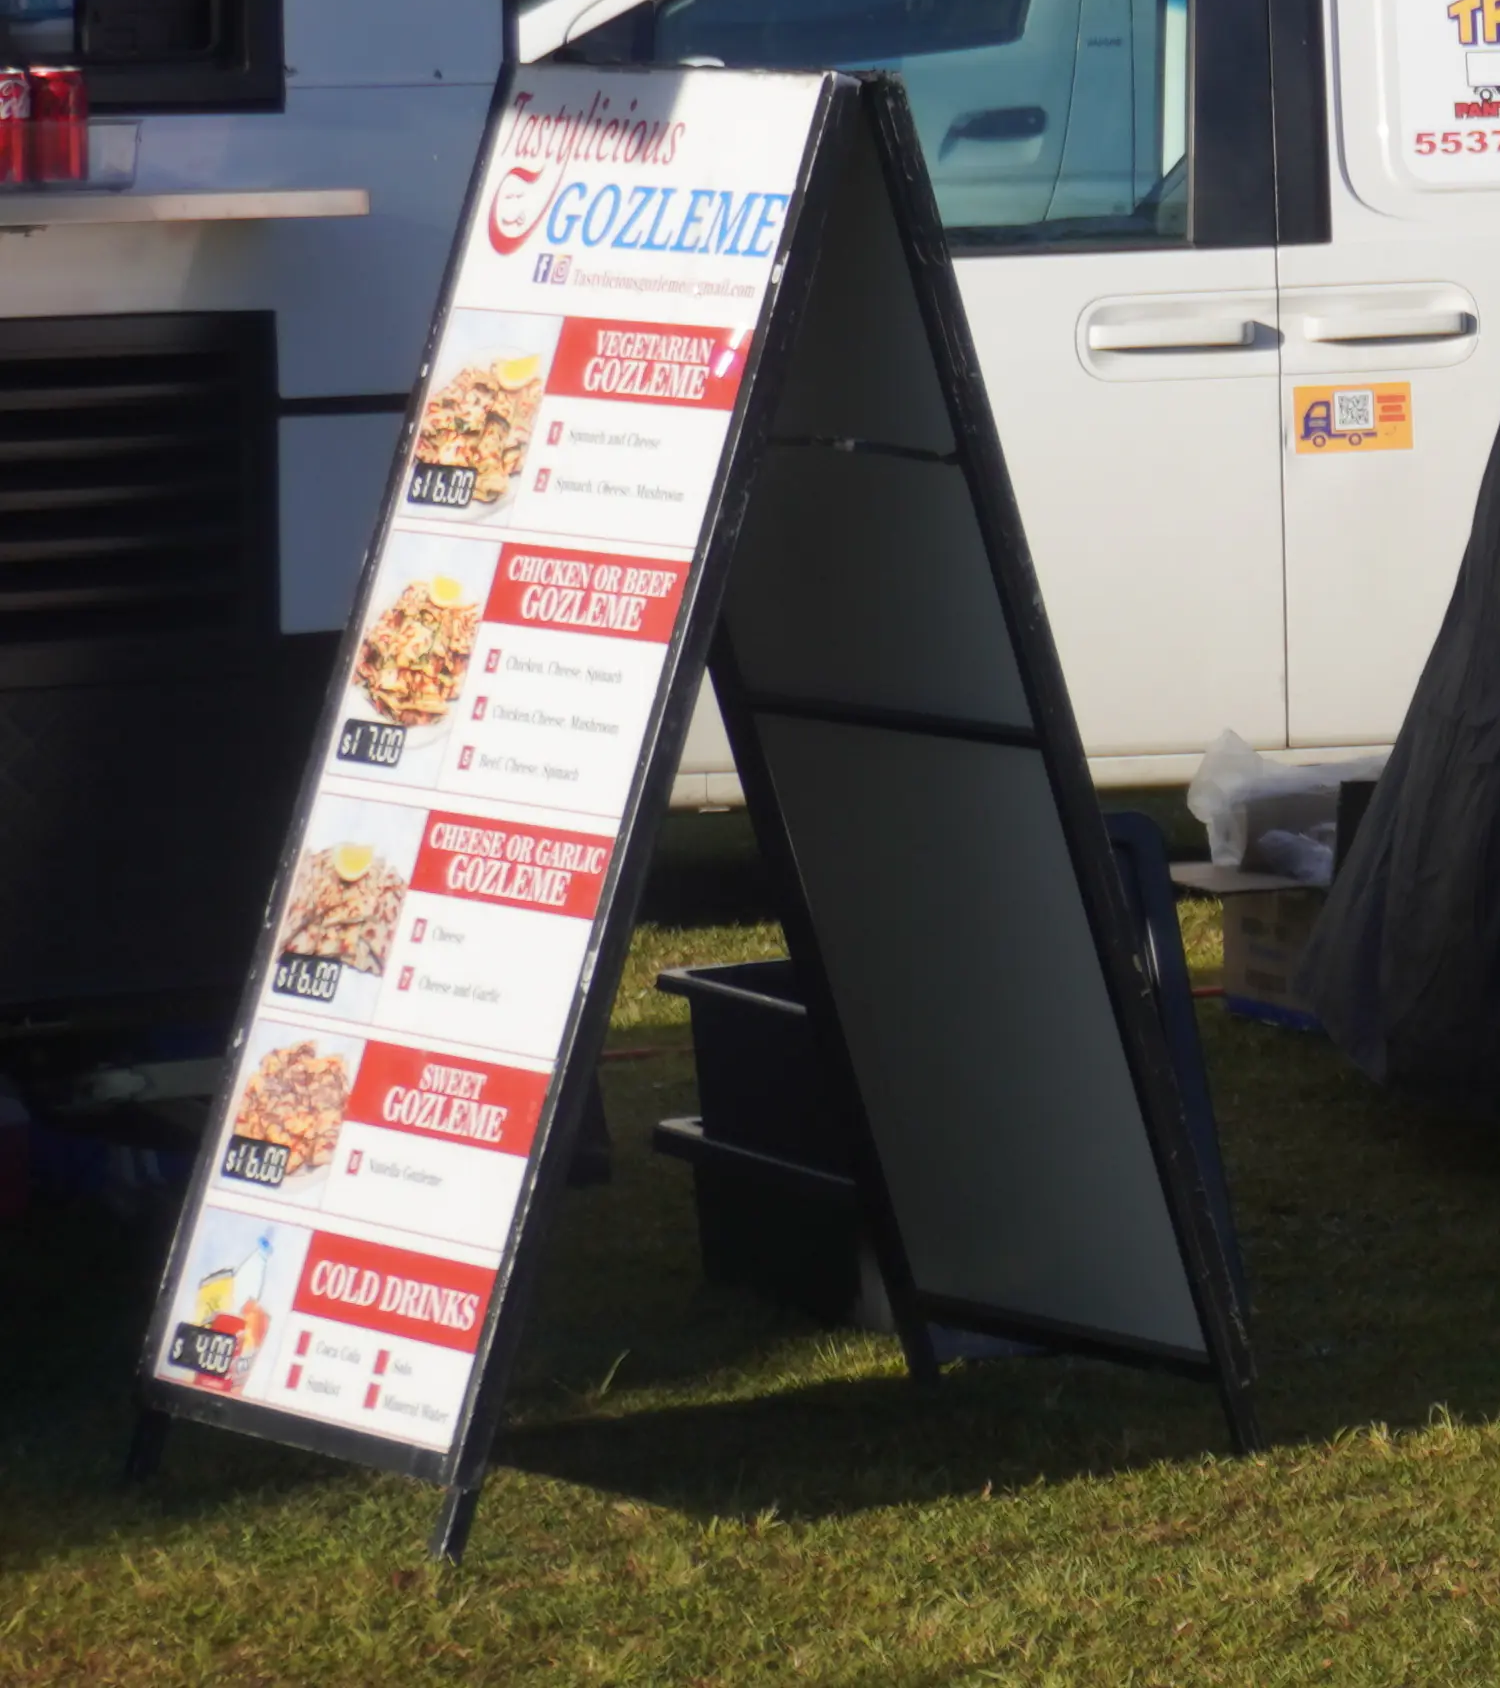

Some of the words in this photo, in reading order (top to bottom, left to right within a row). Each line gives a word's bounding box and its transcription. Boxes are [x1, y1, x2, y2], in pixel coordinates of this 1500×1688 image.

[501, 90, 686, 167] Tastylicious
[546, 181, 790, 258] GOZLEME
[596, 329, 716, 362] VEGETARIAN
[583, 358, 709, 400] GOZLEME
[508, 554, 590, 585] CHICKEN
[594, 565, 620, 590] OR
[622, 568, 677, 599] BEEF
[521, 584, 646, 632] GOZLEME
[430, 822, 506, 856] CHEESE
[506, 836, 534, 863] OR
[535, 843, 607, 875] GARLIC
[447, 855, 572, 906] GOZLEME
[420, 1063, 488, 1096] SWEET
[383, 1087, 509, 1143] GOZLEME
[309, 1259, 379, 1306] COLD
[379, 1275, 479, 1332] DRINKS
